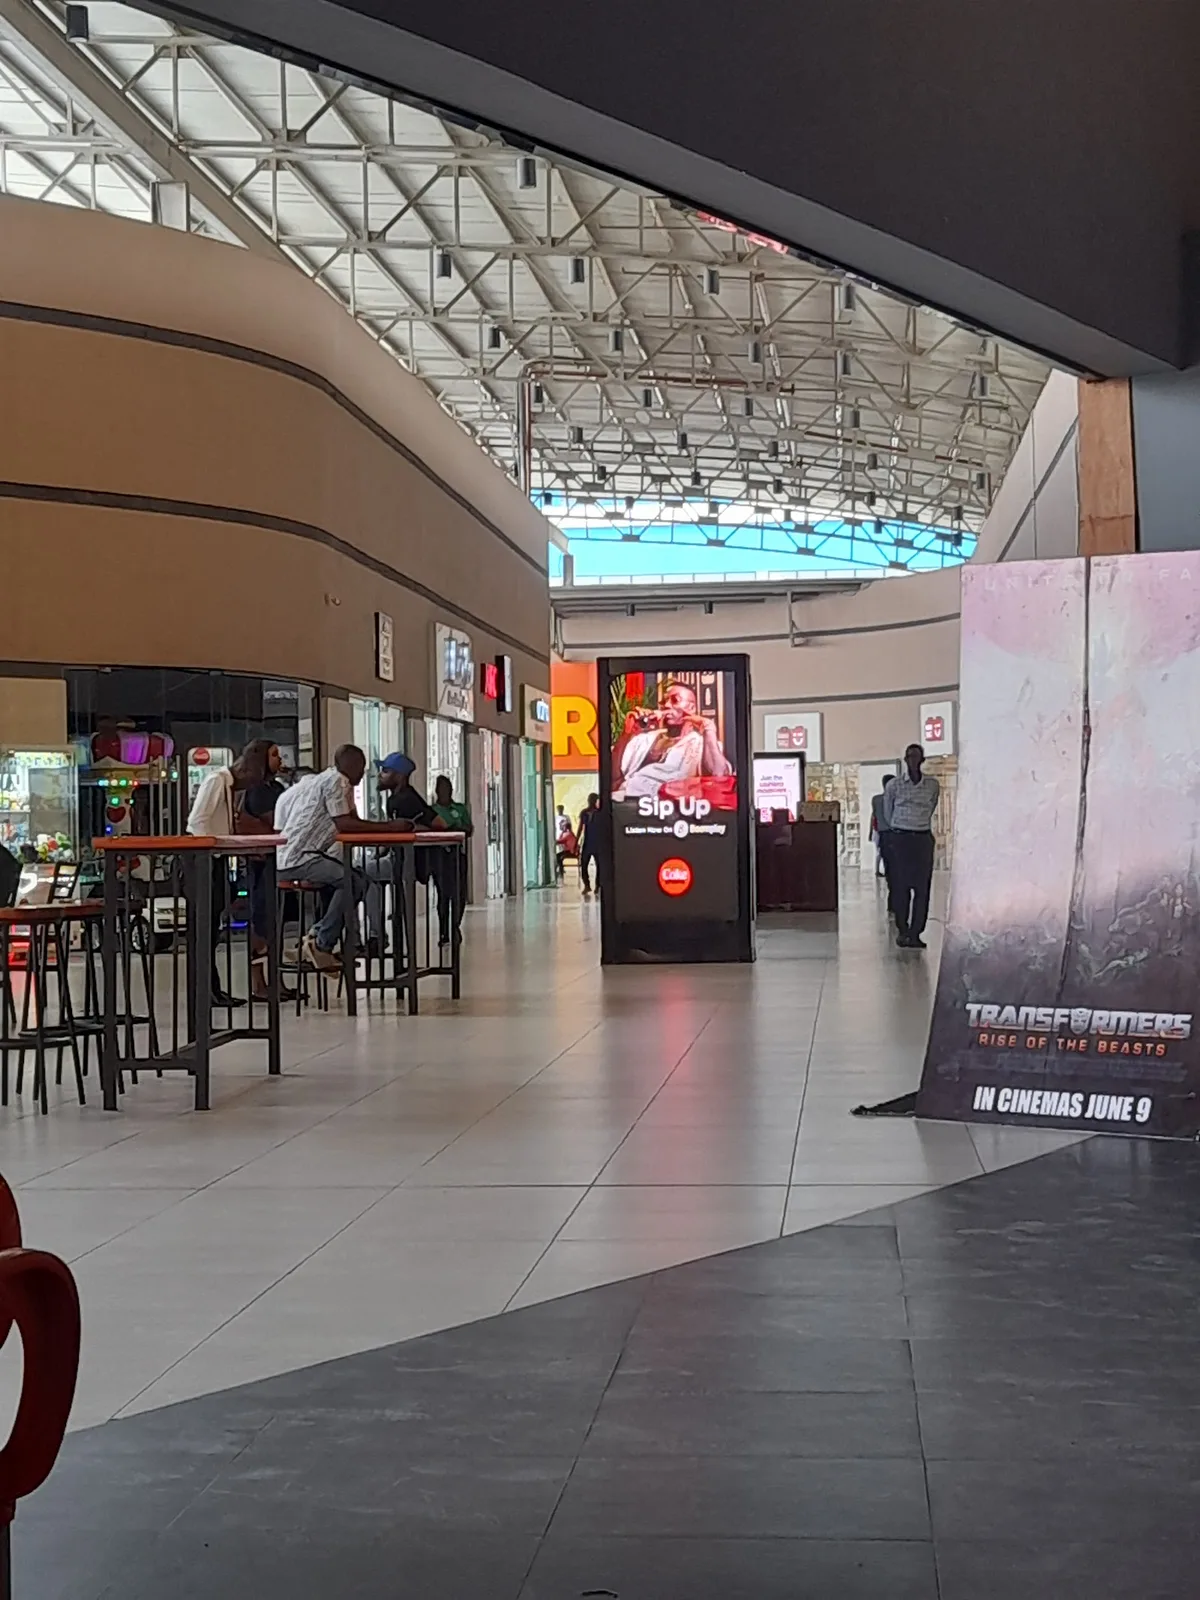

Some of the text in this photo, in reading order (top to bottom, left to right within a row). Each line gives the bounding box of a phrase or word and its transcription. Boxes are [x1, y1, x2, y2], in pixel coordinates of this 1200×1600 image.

[551, 696, 598, 756] R
[638, 796, 711, 820] Sip Up
[662, 868, 688, 881] Coke
[965, 1003, 1193, 1039] TRANSFORMERS
[978, 1033, 1167, 1057] RISE OF THE BEASTS
[973, 1086, 1152, 1123] IN CINEMAS JUNE 9
